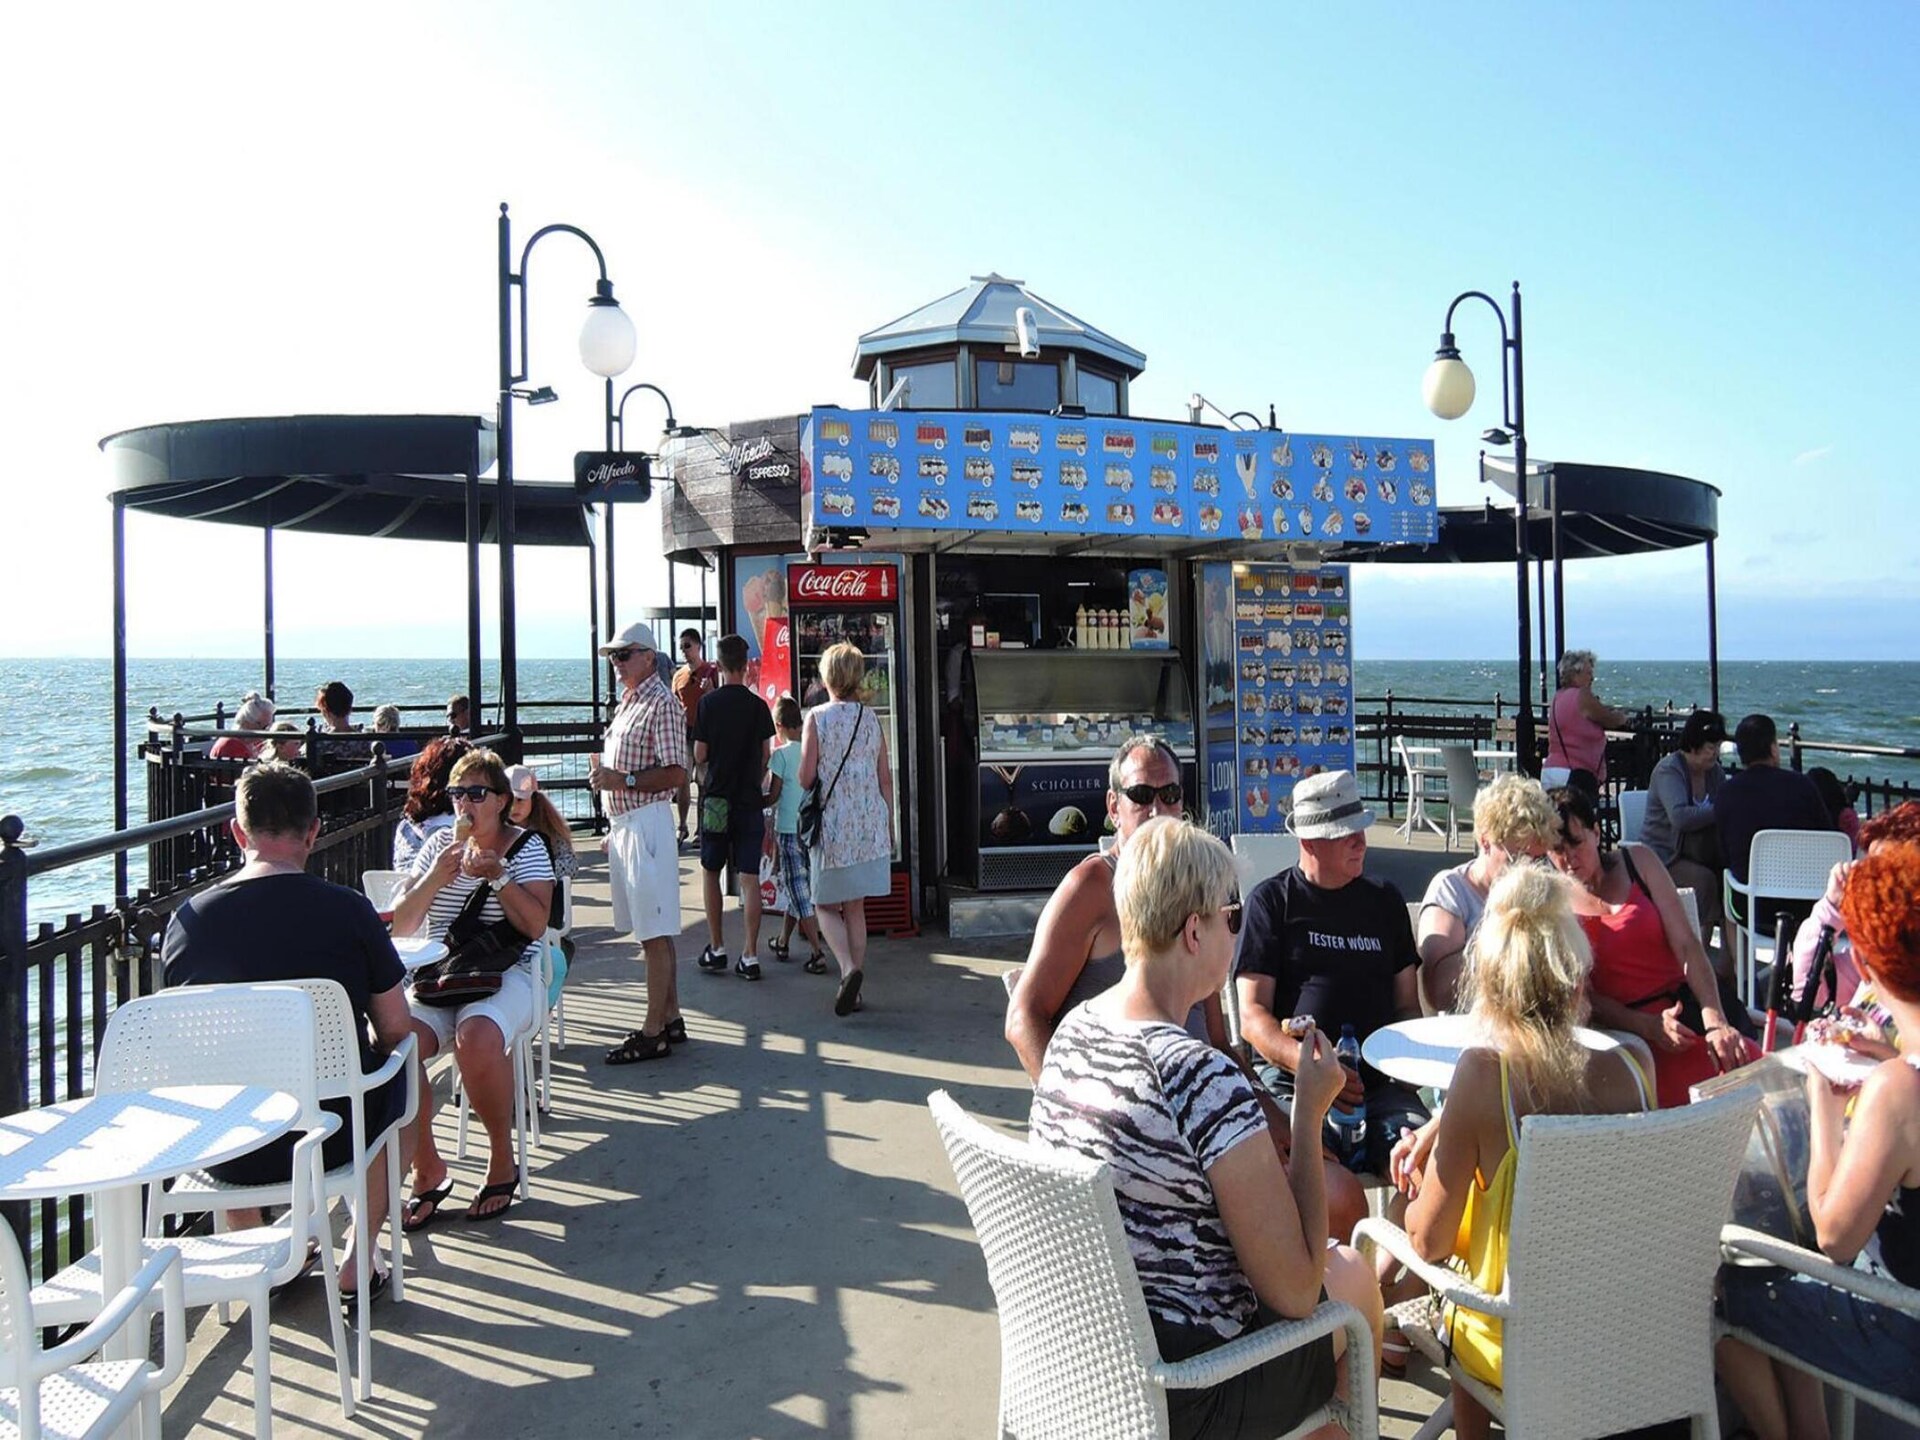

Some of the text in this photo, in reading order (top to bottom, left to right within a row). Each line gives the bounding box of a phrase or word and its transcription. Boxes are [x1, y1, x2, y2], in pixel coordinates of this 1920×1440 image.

[720, 436, 776, 475] Alfredo
[587, 460, 636, 484] Alfredo
[749, 464, 790, 480] ESPRESSO
[798, 569, 869, 597] Coca-Cola
[1211, 760, 1236, 793] LODY
[1308, 931, 1382, 951] TESTER WÓDKI
